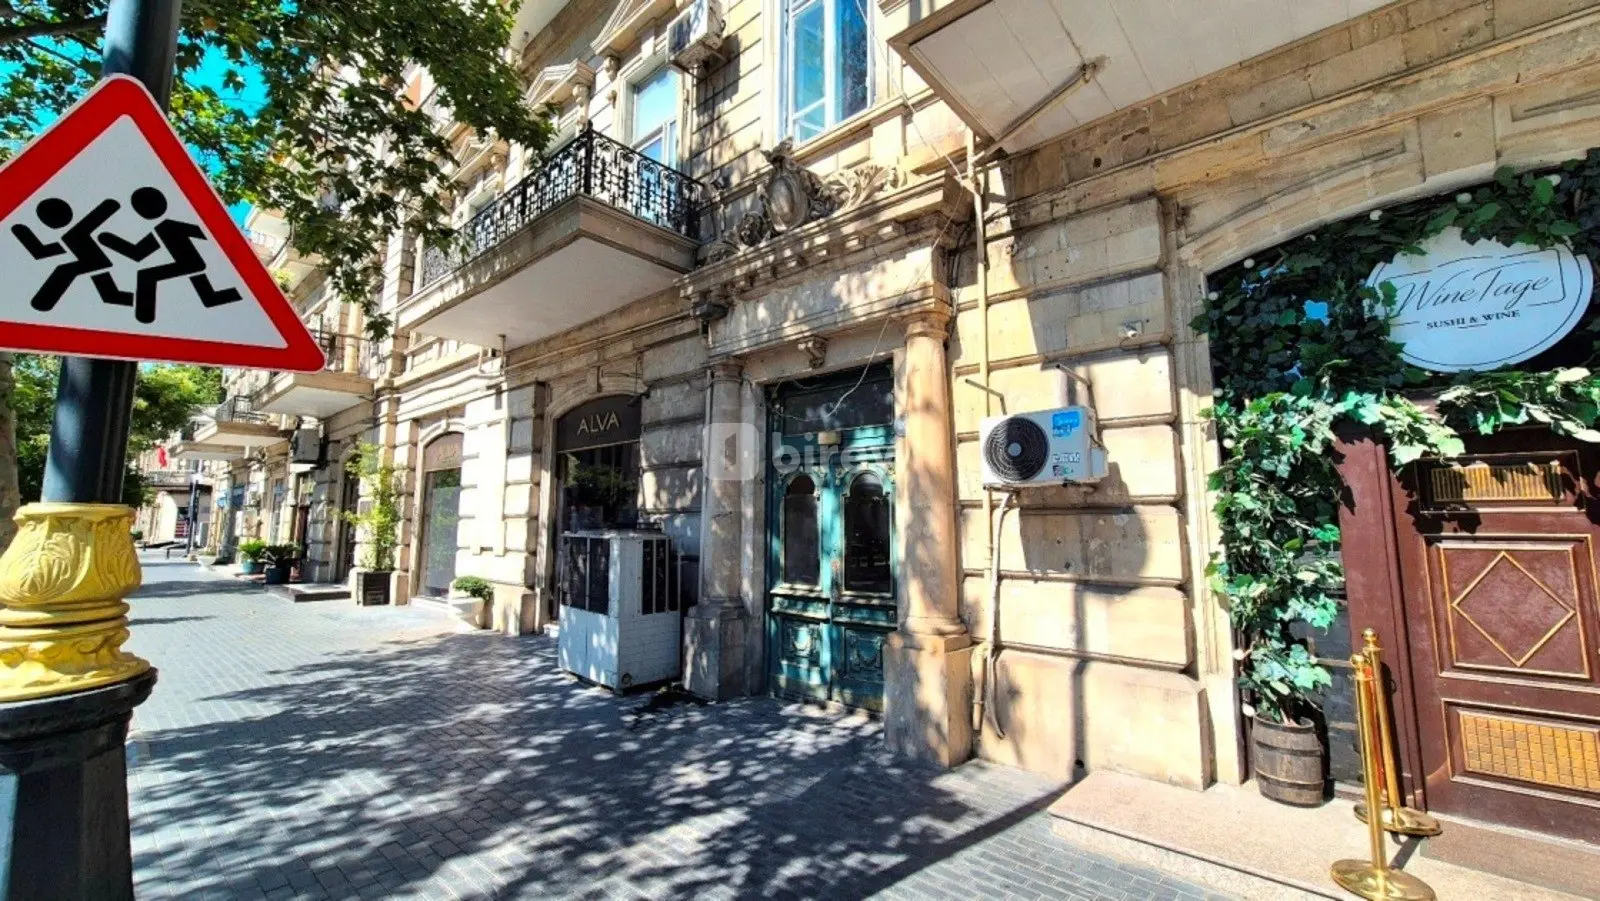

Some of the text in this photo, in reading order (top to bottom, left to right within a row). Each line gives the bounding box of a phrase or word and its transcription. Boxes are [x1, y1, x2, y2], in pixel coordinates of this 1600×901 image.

[1426, 309, 1521, 330] SUSHI & WINE
[577, 411, 620, 436] ALVA
